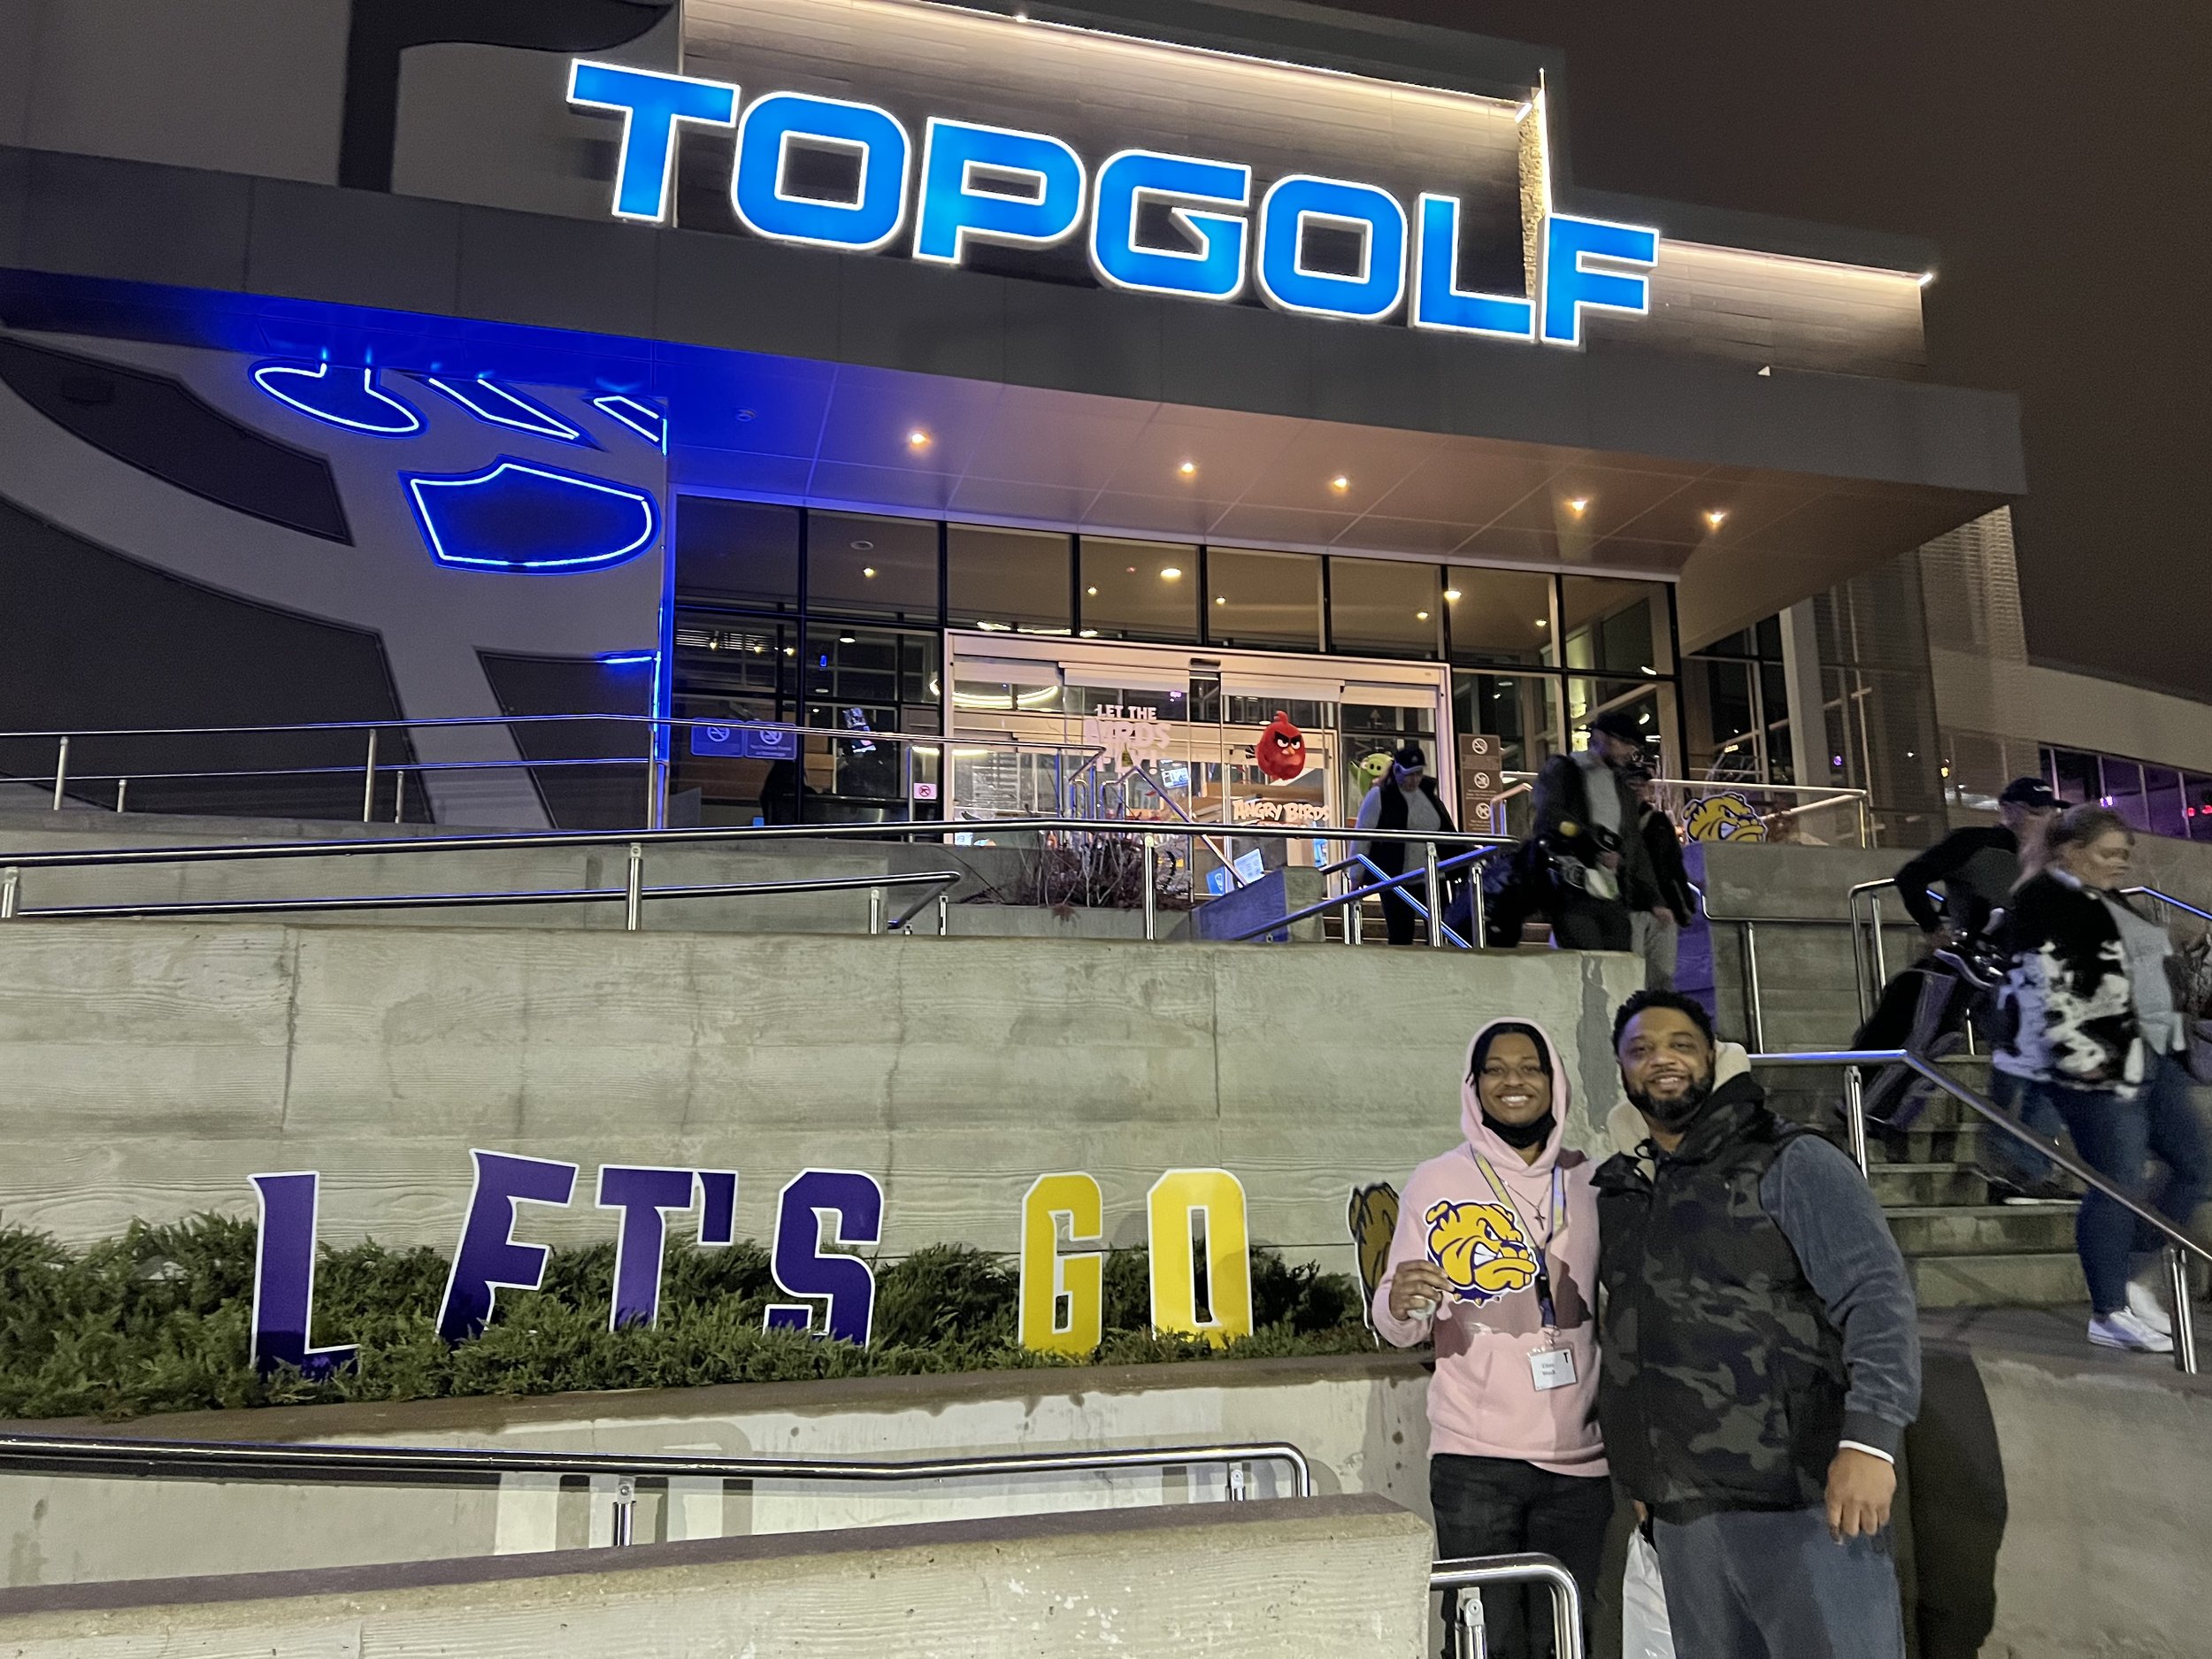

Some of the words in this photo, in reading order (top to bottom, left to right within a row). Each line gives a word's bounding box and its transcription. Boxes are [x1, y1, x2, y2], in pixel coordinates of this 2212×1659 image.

[566, 58, 1661, 347] TOPGOLF
[1096, 703, 1124, 718] LET
[1128, 705, 1157, 720] THE
[1232, 799, 1283, 821] ANGRY
[1283, 802, 1331, 822] BIRDS
[246, 1147, 885, 1382] LET'S
[1018, 1168, 1254, 1355] GO
